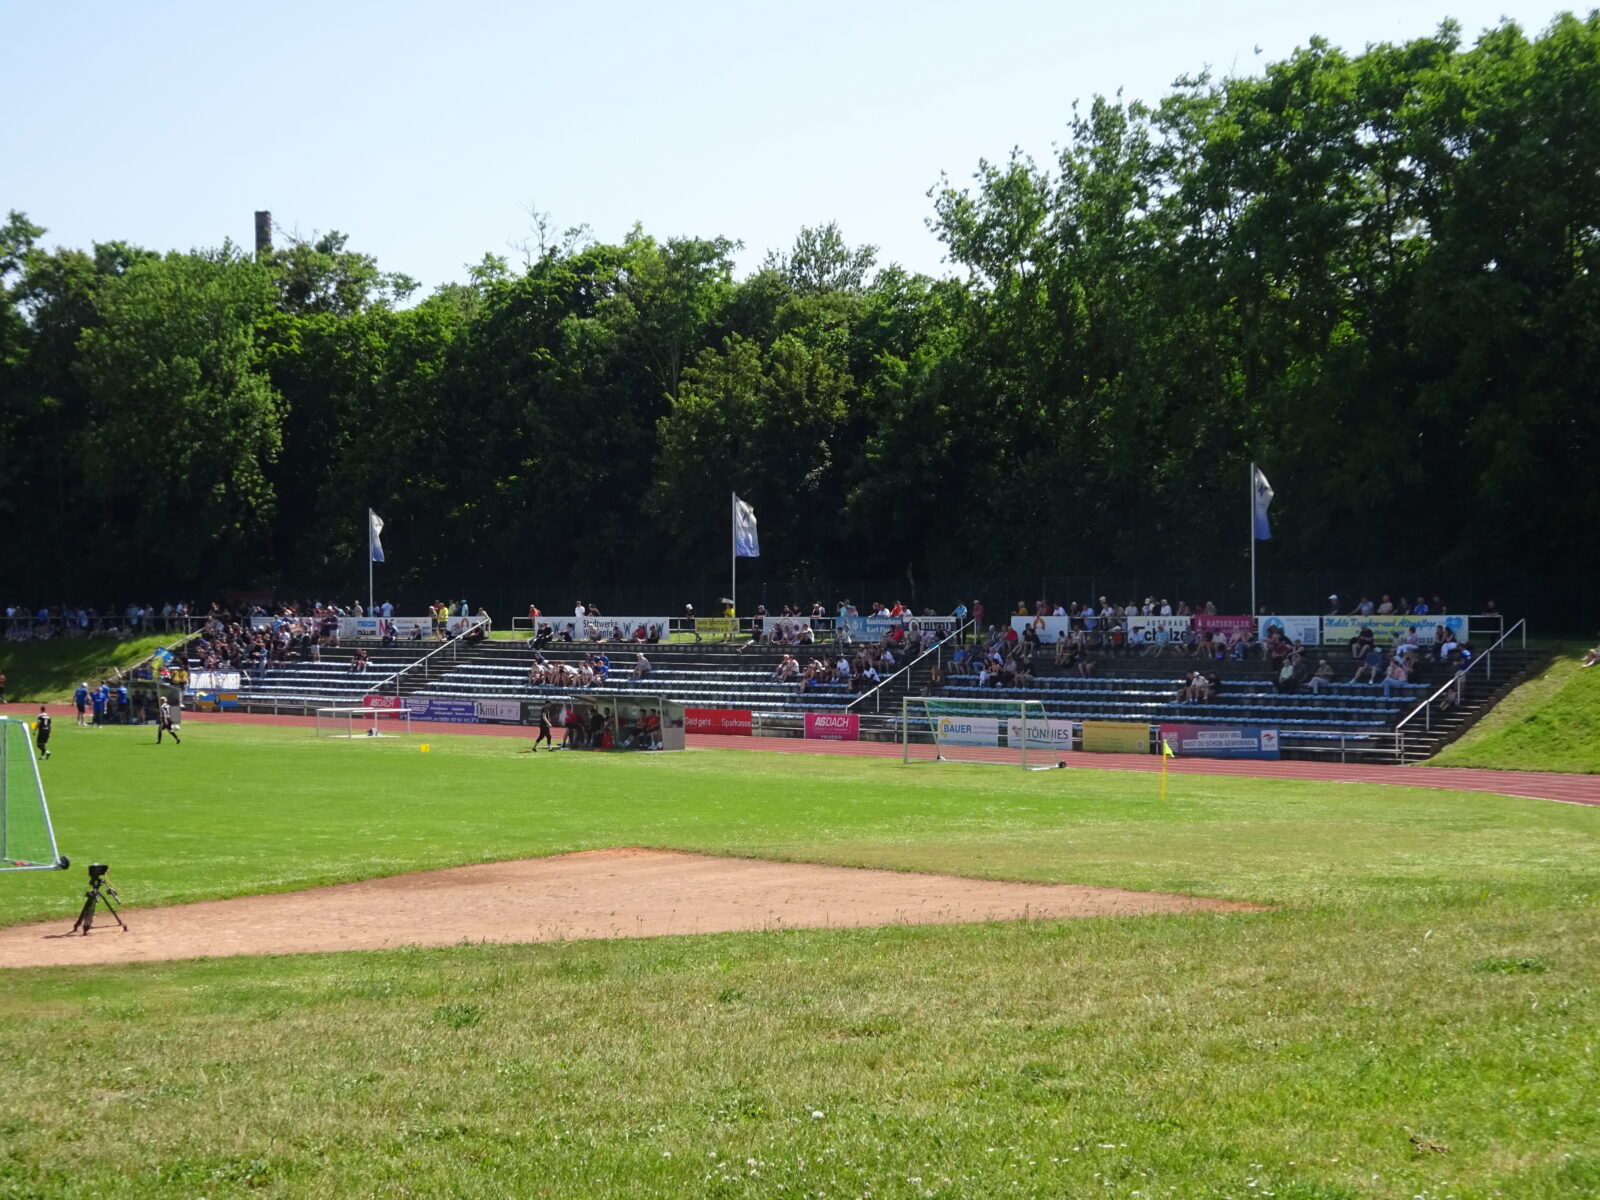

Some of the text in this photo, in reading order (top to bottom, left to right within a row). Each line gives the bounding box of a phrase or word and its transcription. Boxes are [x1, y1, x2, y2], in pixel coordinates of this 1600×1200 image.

[1206, 620, 1250, 628] RATSKELLER
[698, 717, 711, 727] geht
[814, 716, 849, 727] ASDACH
[943, 724, 972, 734] BAUER
